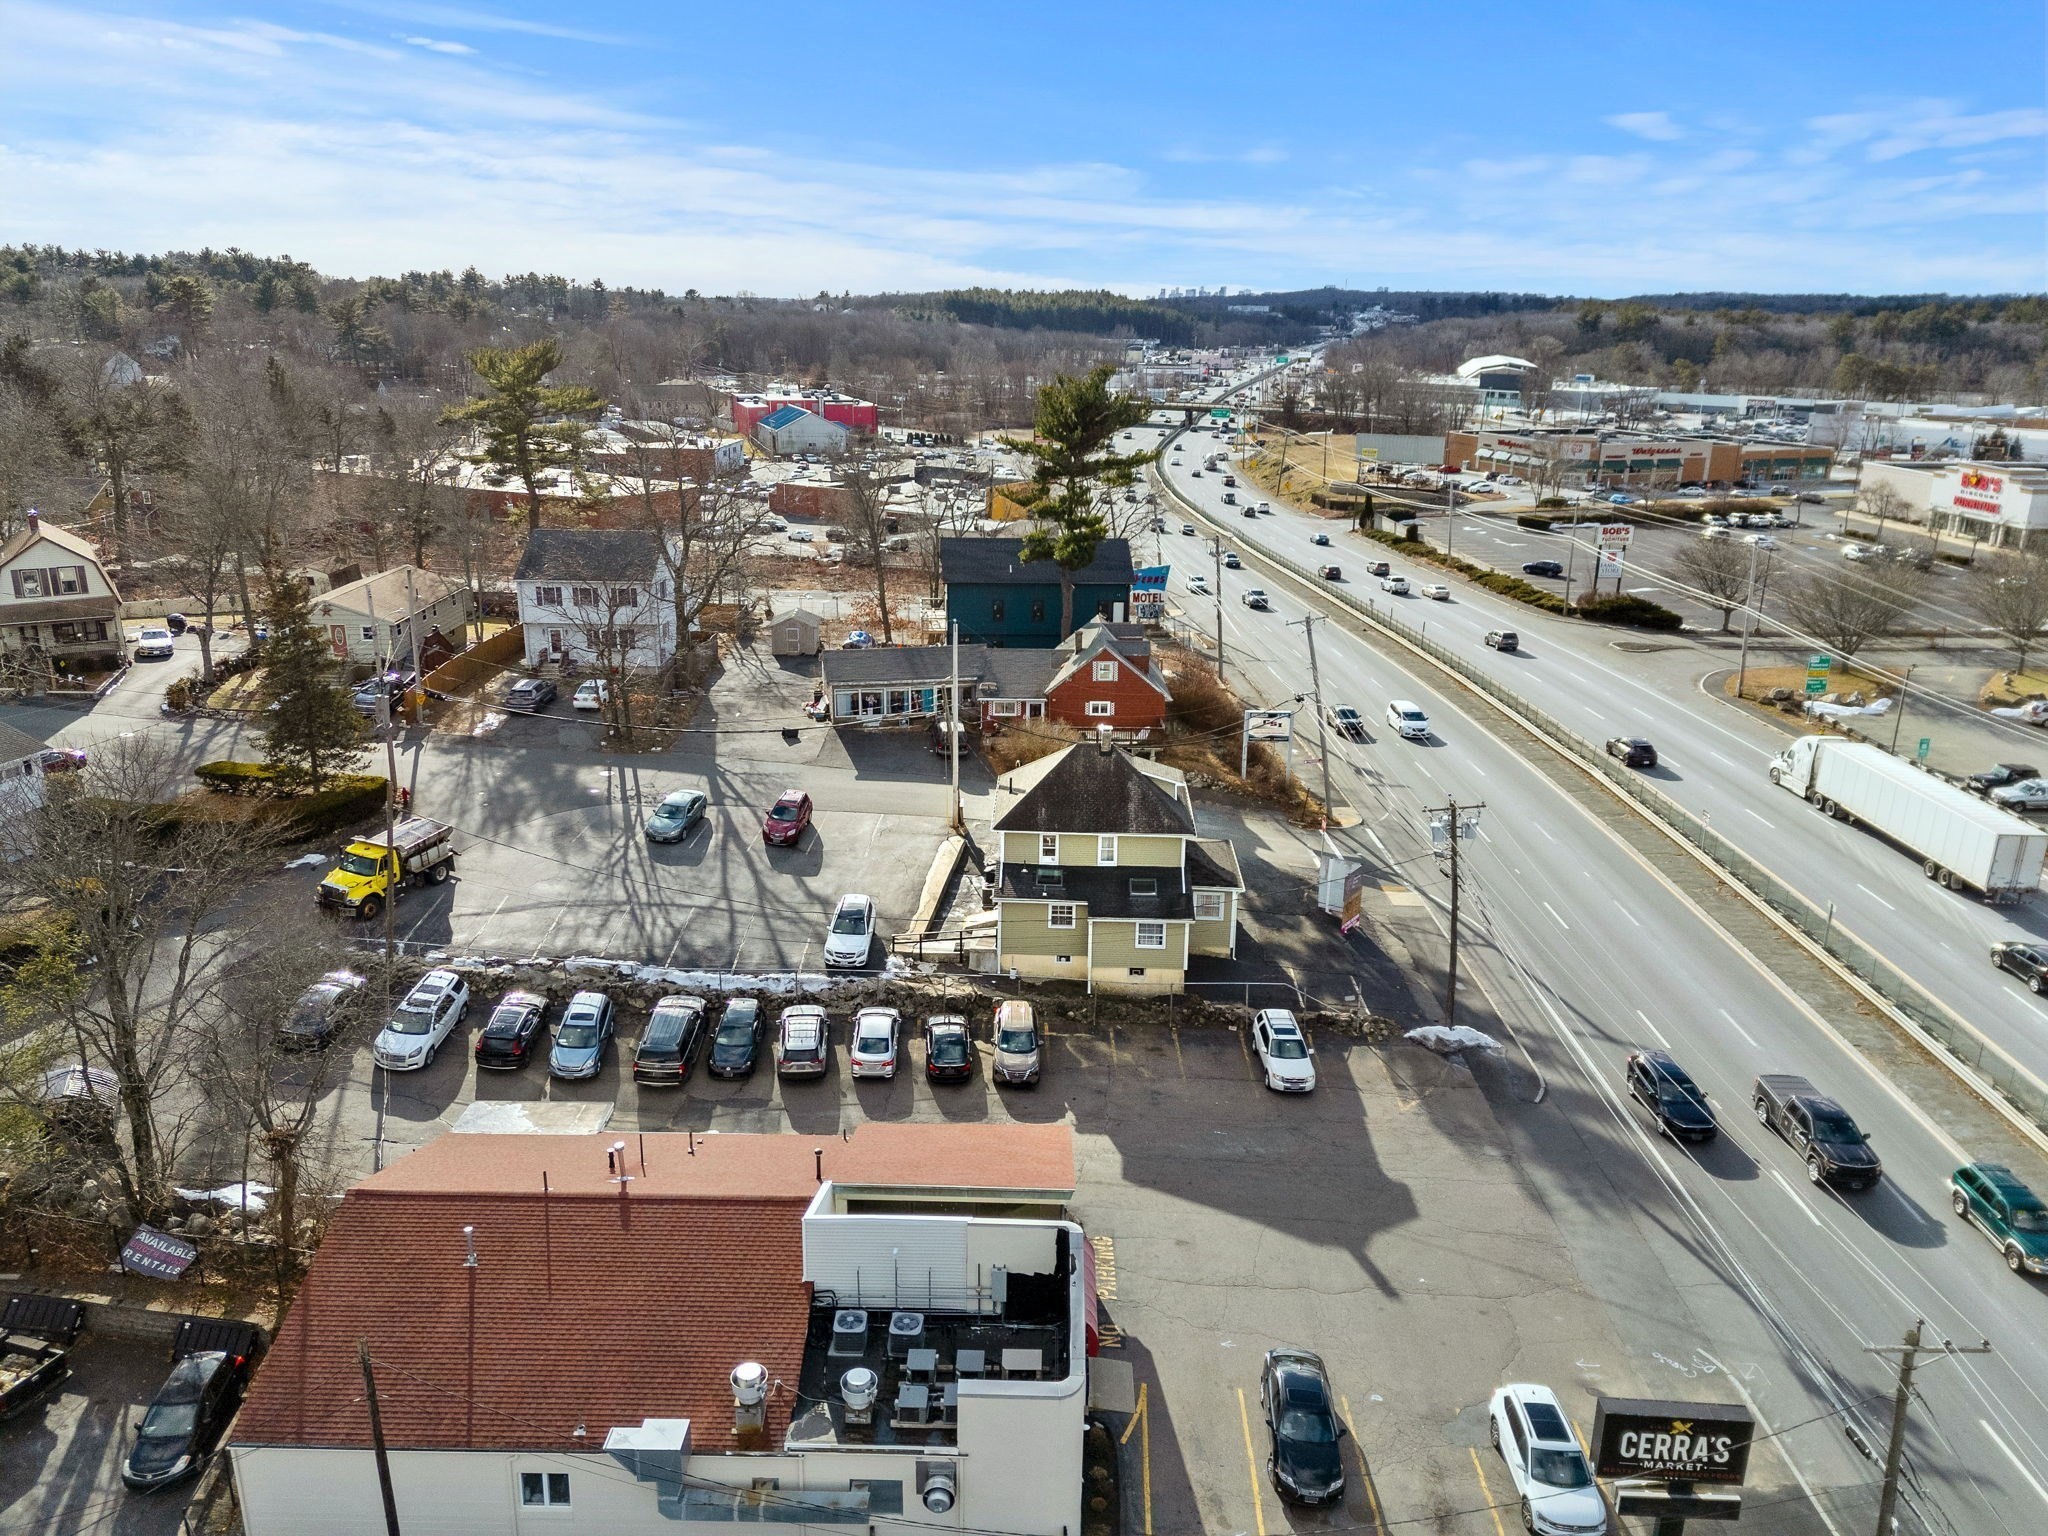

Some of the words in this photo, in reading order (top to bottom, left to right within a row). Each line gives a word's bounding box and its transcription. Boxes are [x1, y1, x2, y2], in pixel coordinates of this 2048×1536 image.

[1632, 447, 1682, 456] Walgreens
[1602, 527, 1630, 535] BOB'S
[1132, 592, 1165, 603] MOTEL
[136, 1231, 197, 1260] AVAILABLE
[123, 1248, 181, 1275] RENTALS
[1093, 1236, 1118, 1300] PARKING
[1098, 1324, 1121, 1348] NO
[1620, 1431, 1732, 1463] CERRA'S
[1643, 1460, 1703, 1471] MARKET
